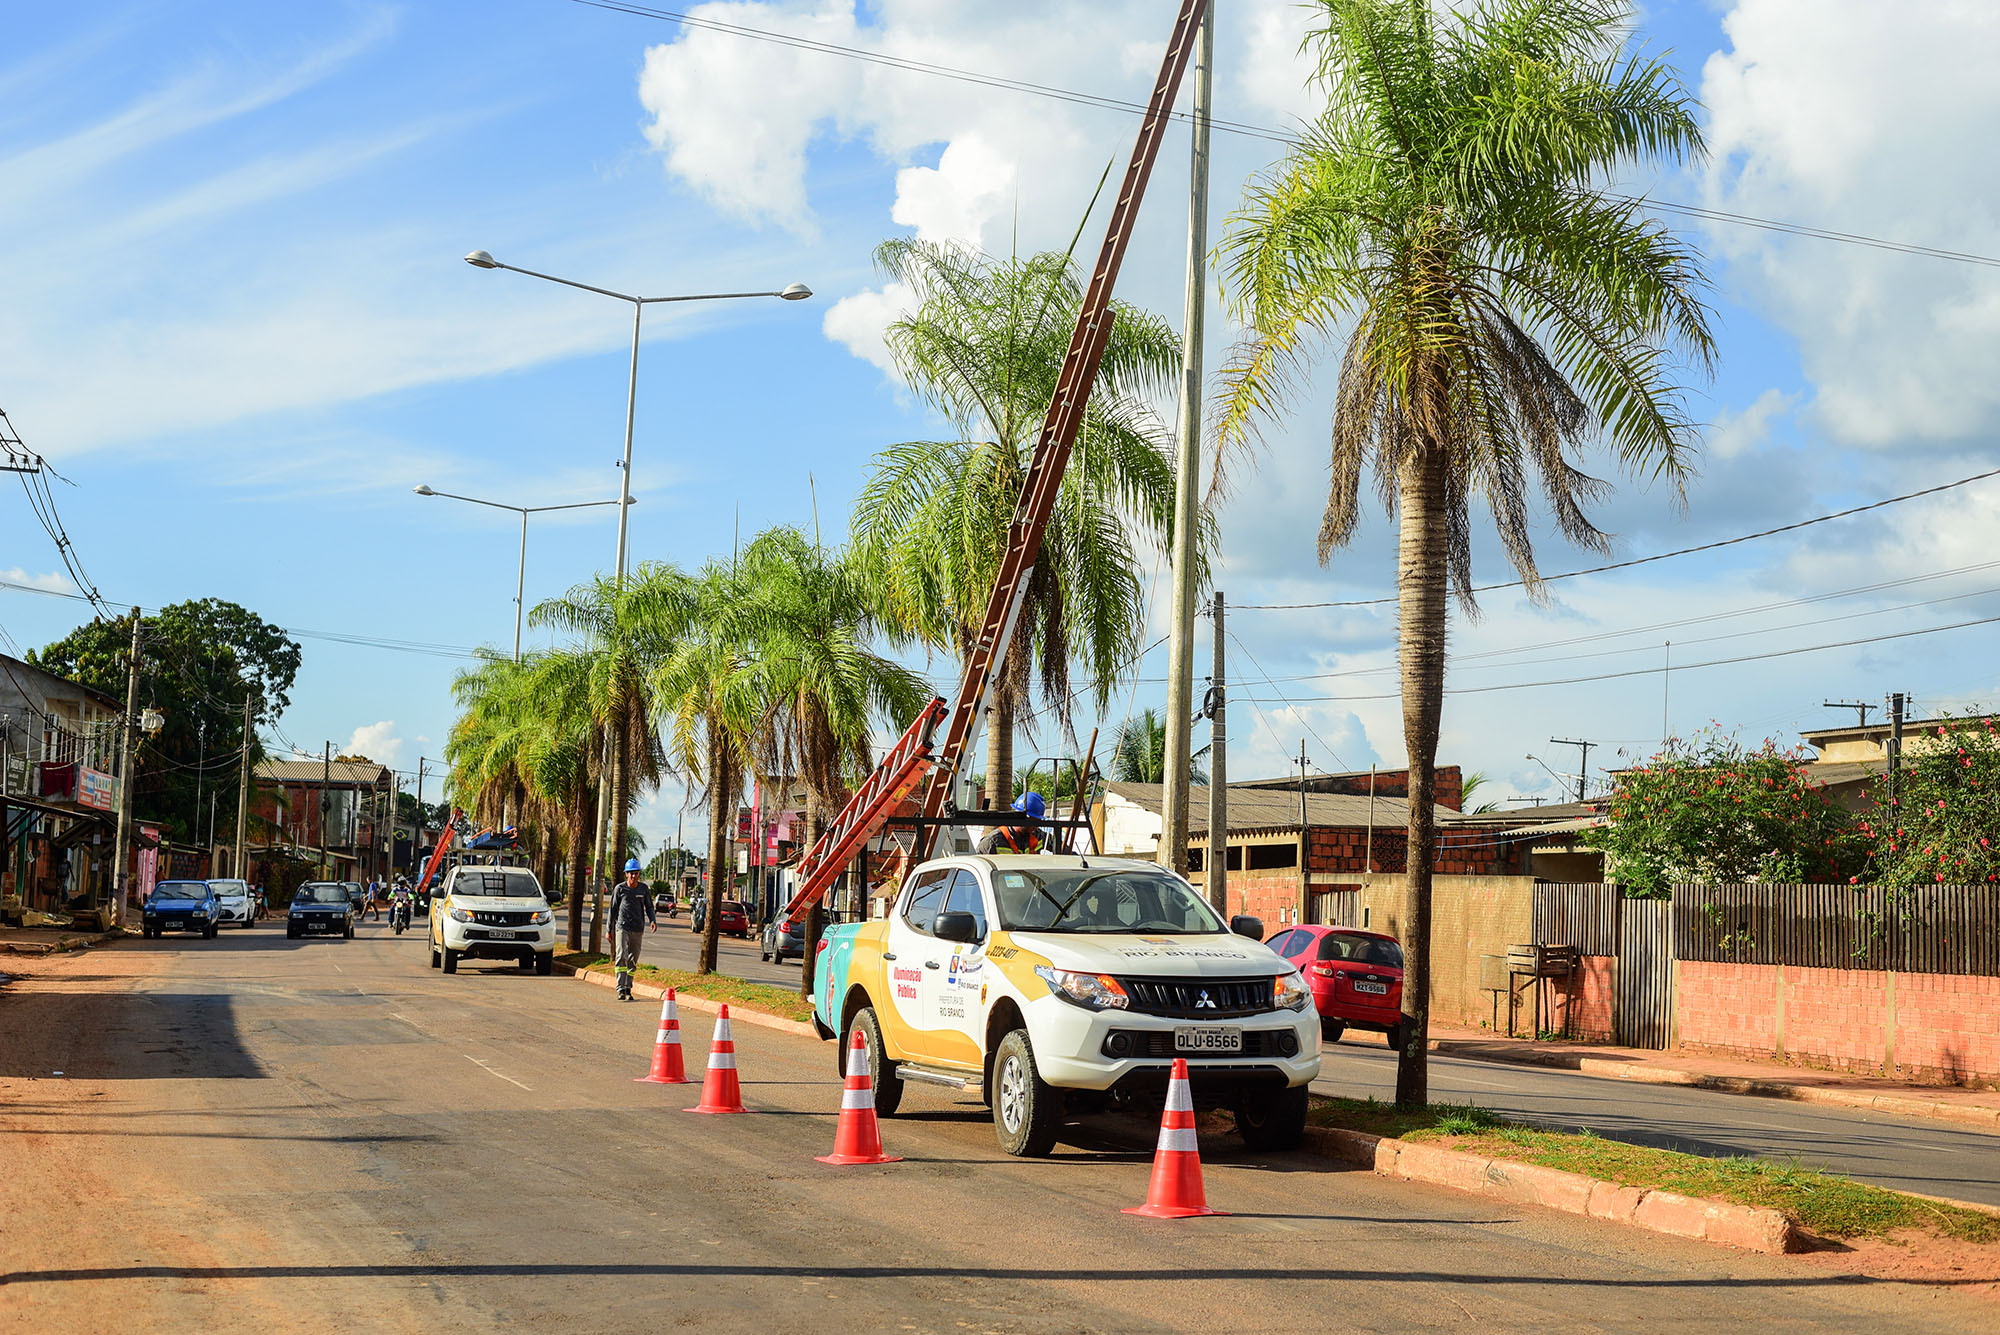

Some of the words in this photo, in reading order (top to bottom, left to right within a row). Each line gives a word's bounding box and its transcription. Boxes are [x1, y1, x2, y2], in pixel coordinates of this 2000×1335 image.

[1166, 951, 1247, 959] BRANCO
[893, 967, 922, 982] Iluminação
[897, 984, 917, 999] Pública
[939, 1007, 947, 1017] RIO
[947, 1007, 965, 1018] BRANCO
